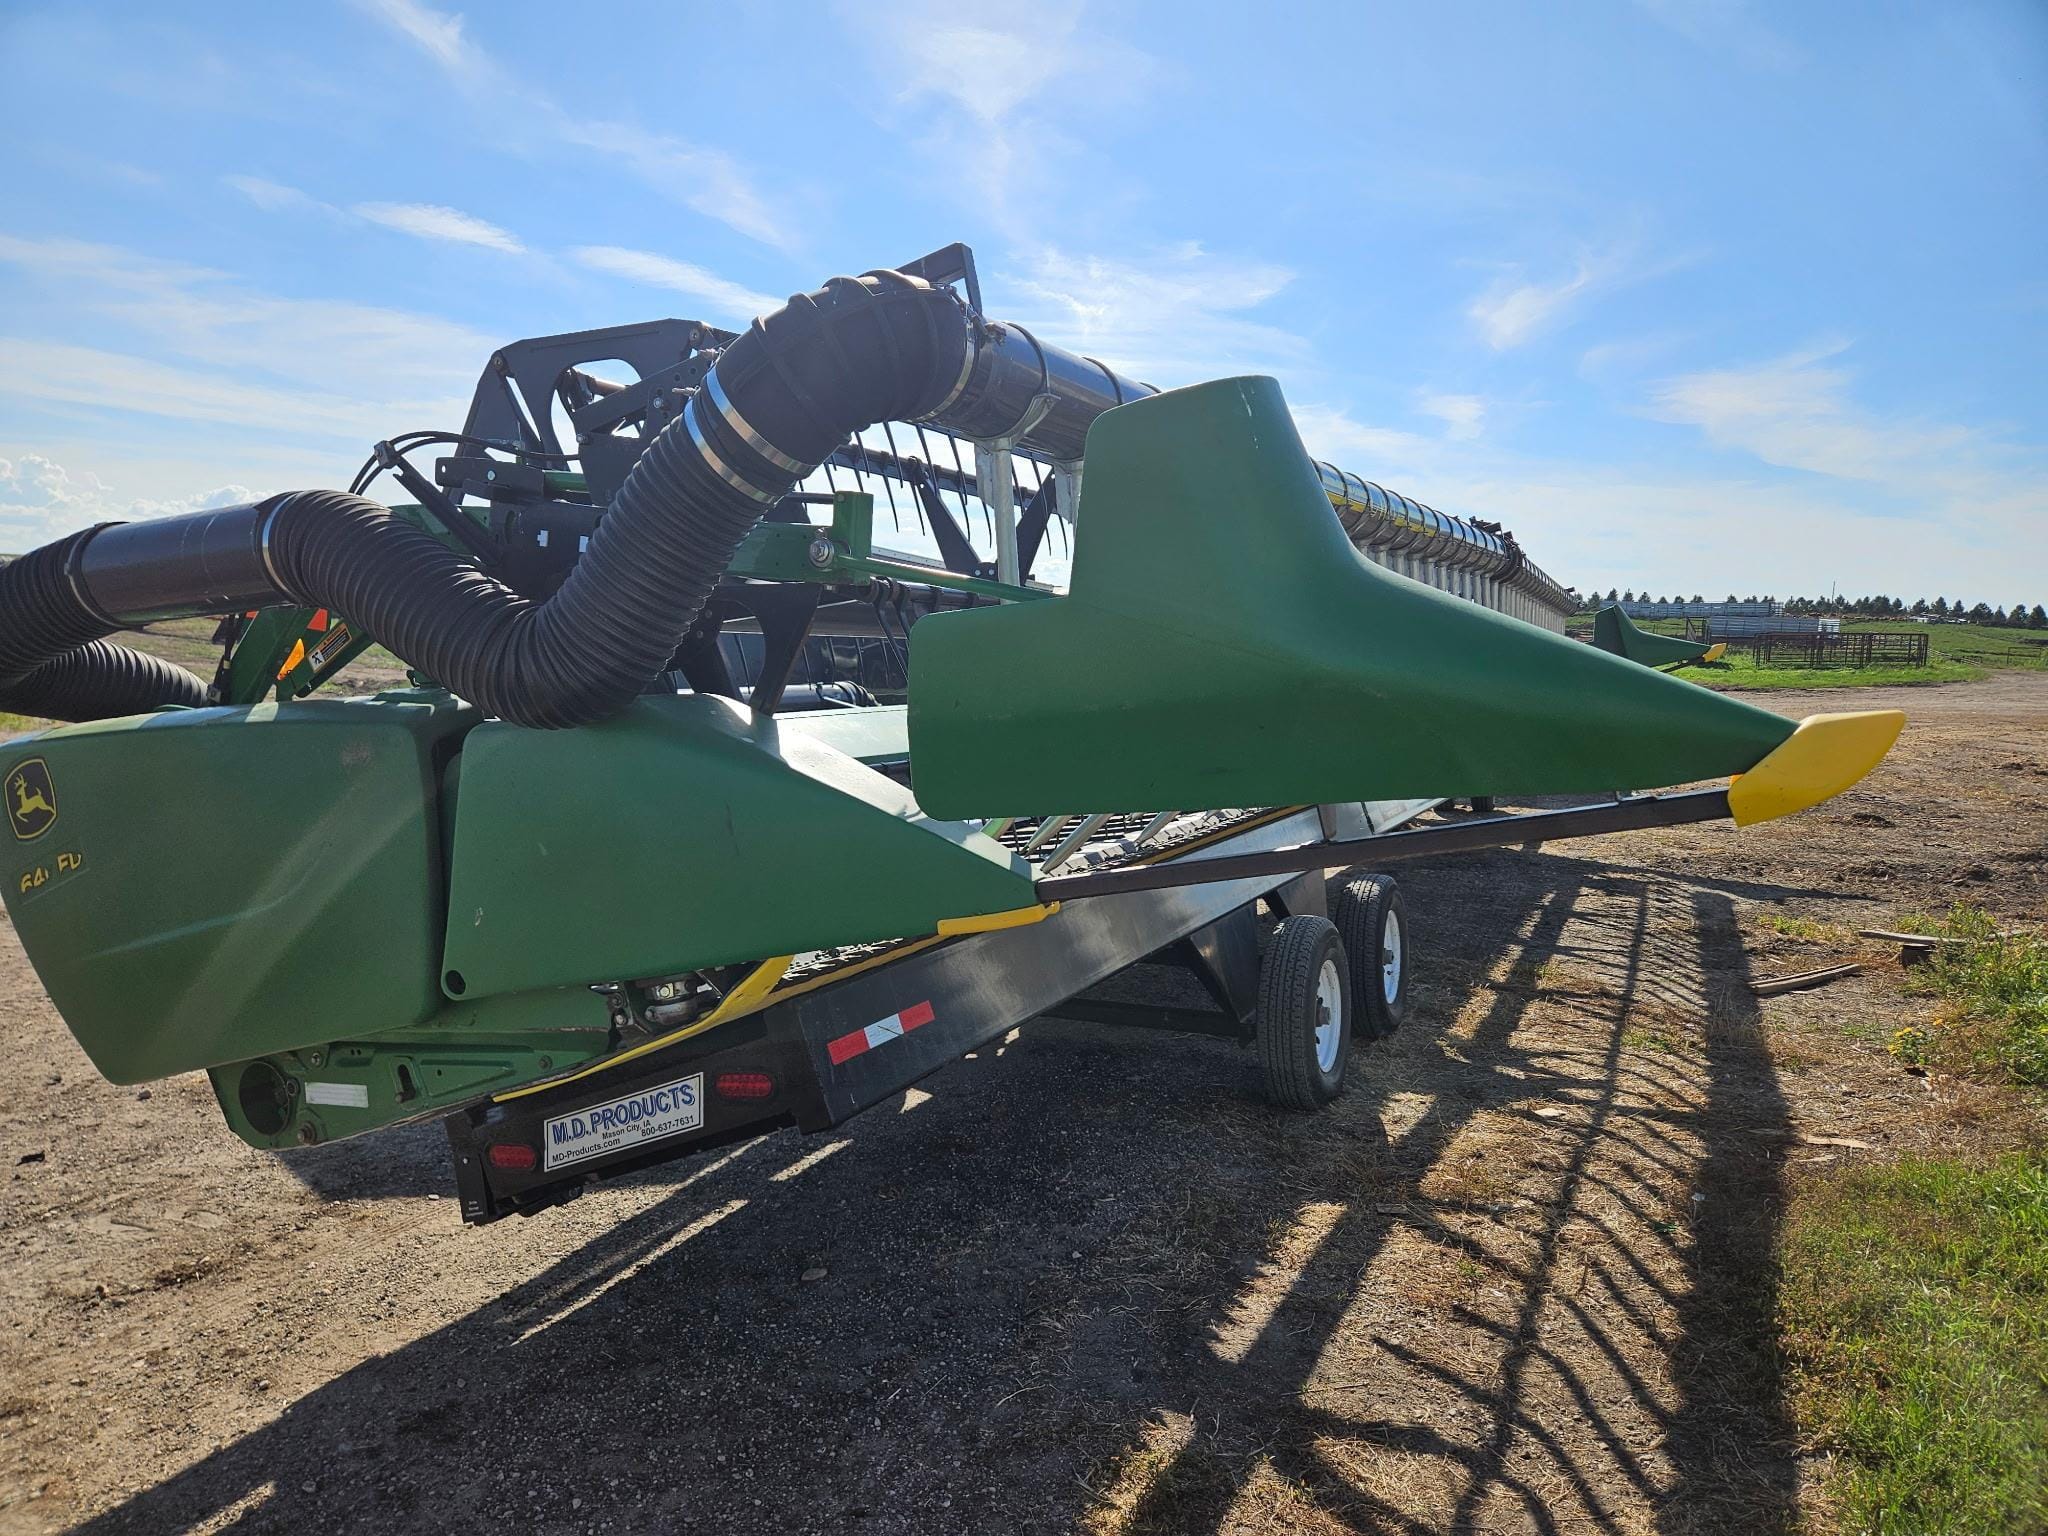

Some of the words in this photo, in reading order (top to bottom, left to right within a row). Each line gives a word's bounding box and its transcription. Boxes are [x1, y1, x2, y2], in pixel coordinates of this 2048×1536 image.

[590, 1084, 695, 1133] PRODUCTS
[602, 1129, 625, 1140] Mason
[626, 1124, 642, 1134] City,
[641, 1115, 694, 1137] 800-637-7631
[552, 1138, 620, 1163] MD-Products.com
